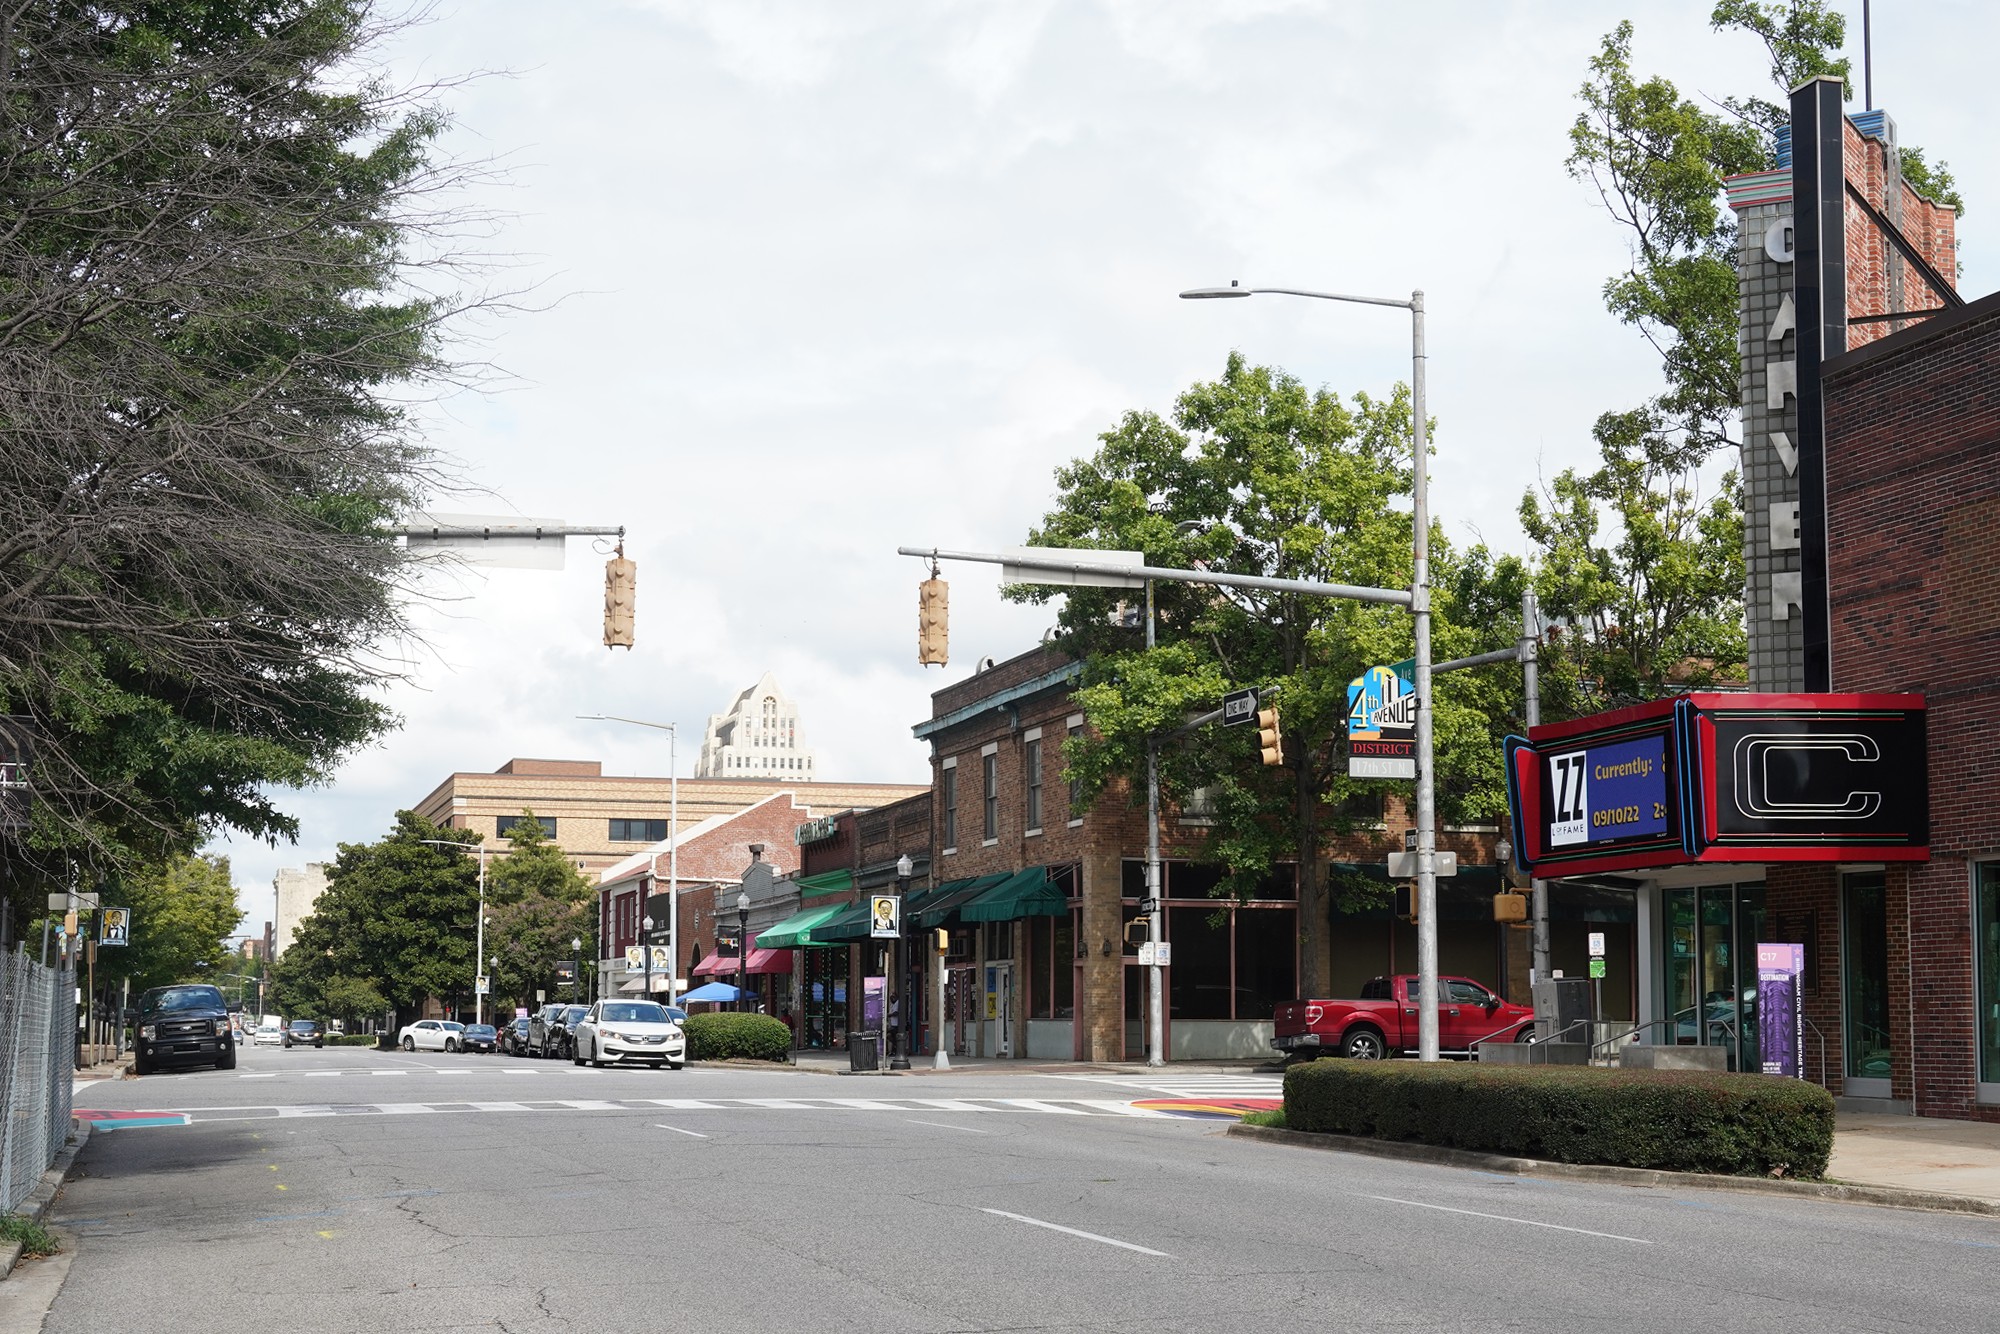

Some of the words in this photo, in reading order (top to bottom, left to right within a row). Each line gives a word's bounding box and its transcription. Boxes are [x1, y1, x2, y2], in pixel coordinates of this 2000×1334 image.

[1228, 702, 1237, 715] ONE
[1239, 699, 1248, 712] WAY
[1349, 687, 1379, 728] 4th
[1373, 695, 1415, 725] AVENUE
[1353, 743, 1412, 754] DISTRICT
[1356, 761, 1378, 774] 17th
[1381, 761, 1393, 774] ST
[1595, 756, 1652, 780] Currently:
[1734, 733, 1881, 819] C
[1593, 805, 1640, 827] 09/10/22
[1563, 824, 1584, 834] FAME
[1760, 952, 1777, 961] C17
